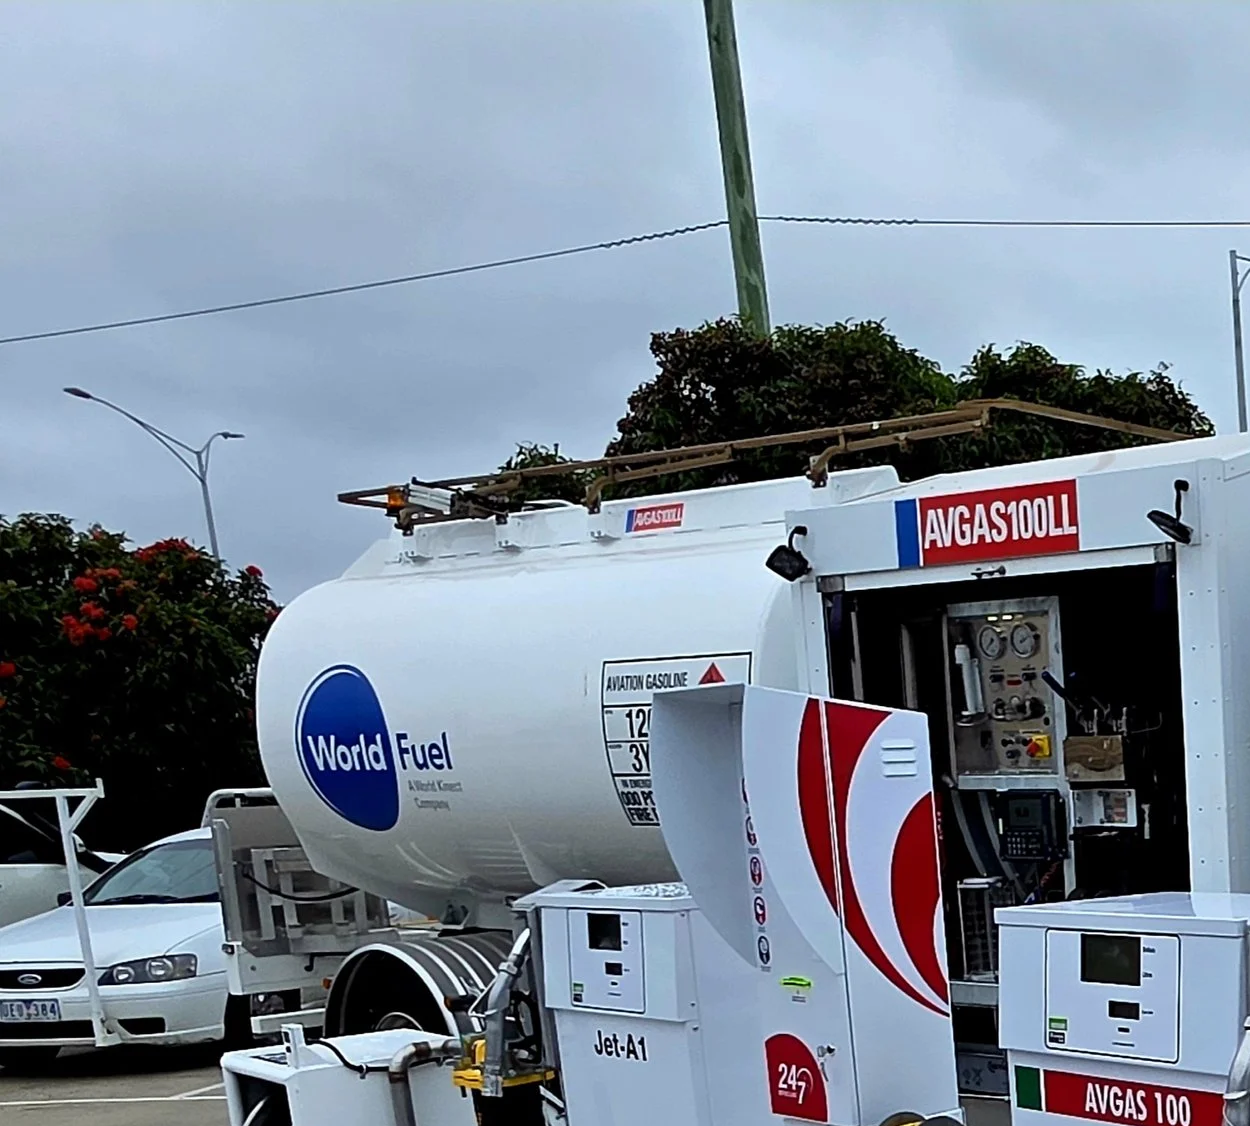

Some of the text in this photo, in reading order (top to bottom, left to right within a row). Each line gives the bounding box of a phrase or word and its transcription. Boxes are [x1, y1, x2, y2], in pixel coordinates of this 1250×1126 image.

[924, 494, 1077, 549] AVGAS100LL
[606, 672, 688, 692] AVIATION GASOLINE
[625, 708, 652, 739] 12
[307, 732, 453, 771] World Fuel
[594, 1030, 647, 1061] Jet-A1
[1085, 1082, 1191, 1126] AVGAS 100
